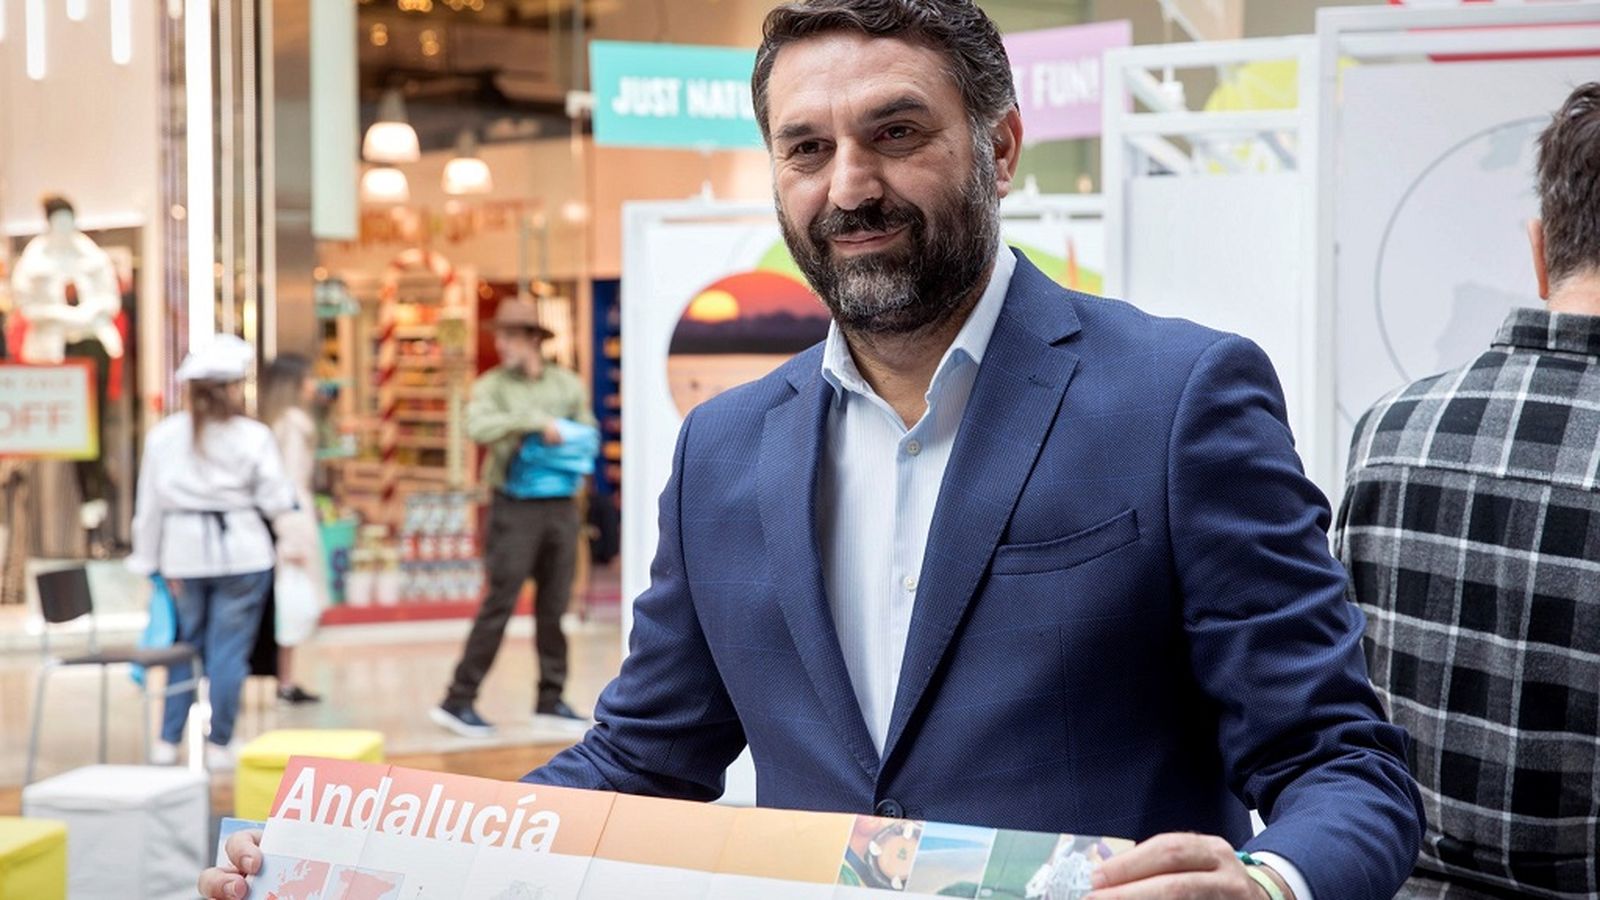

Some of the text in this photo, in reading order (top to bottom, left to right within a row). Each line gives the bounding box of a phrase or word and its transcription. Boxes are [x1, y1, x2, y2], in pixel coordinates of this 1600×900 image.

[612, 76, 680, 117] JUST
[1032, 57, 1100, 109] FUN!
[274, 767, 561, 853] Andalucía
